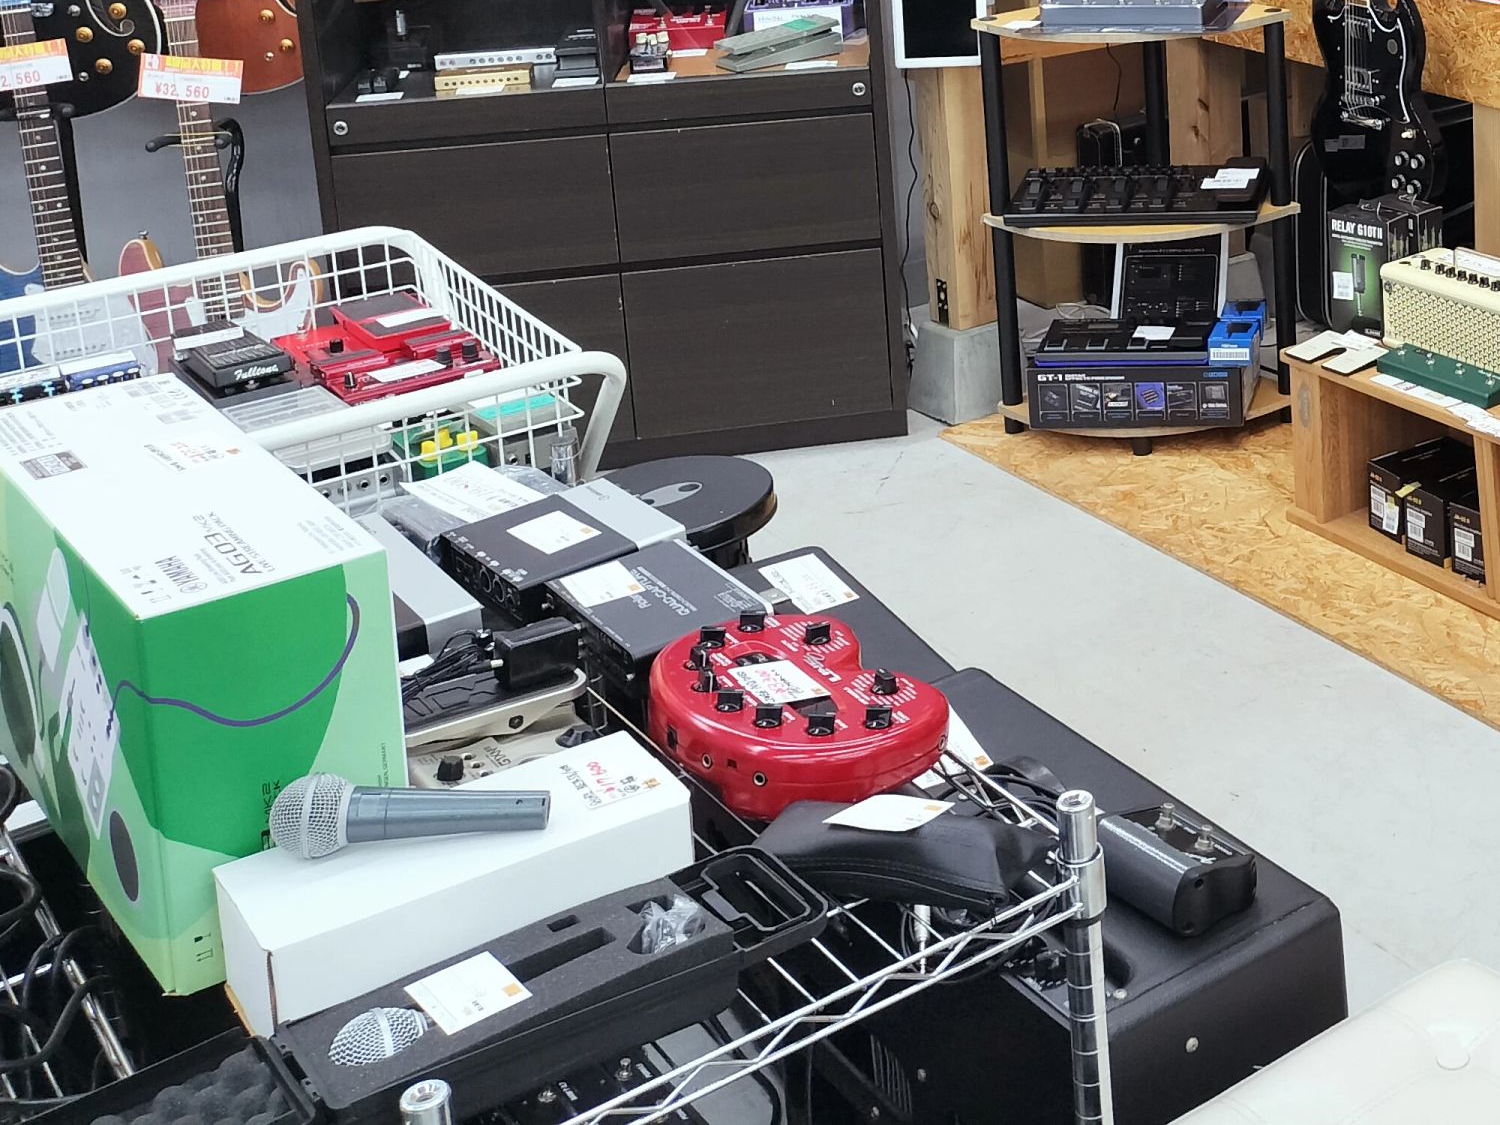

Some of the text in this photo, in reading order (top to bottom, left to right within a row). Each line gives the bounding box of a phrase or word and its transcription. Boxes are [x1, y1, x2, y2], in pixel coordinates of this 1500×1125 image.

[1331, 218, 1356, 235] RELAY
[234, 363, 279, 382] Fulltone
[1037, 374, 1063, 382] GT-1
[155, 555, 200, 587] YAMAHA
